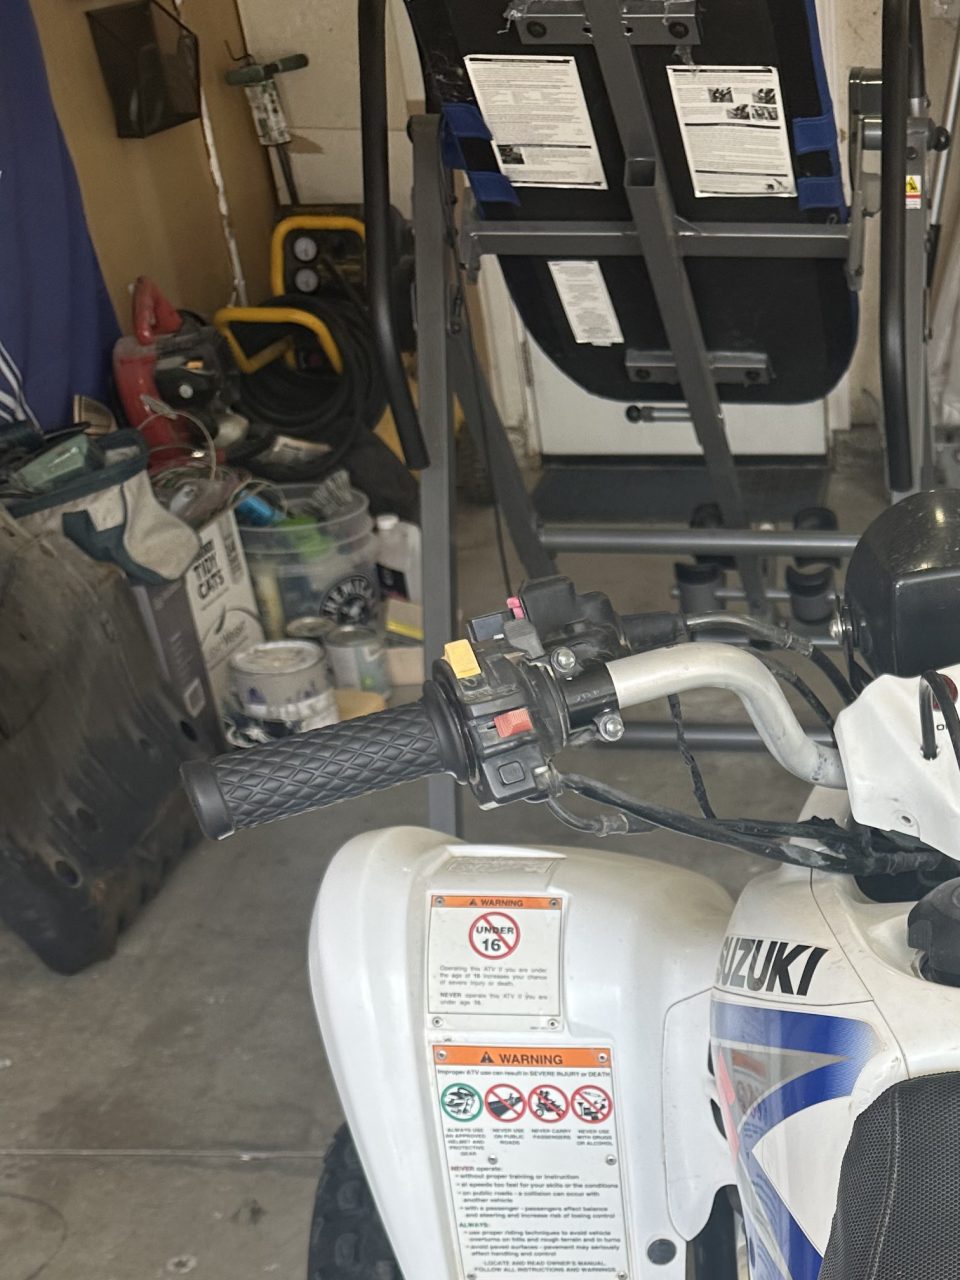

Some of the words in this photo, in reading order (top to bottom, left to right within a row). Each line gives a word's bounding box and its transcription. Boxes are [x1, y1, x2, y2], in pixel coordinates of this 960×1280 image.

[481, 898, 524, 907] WARNING
[476, 926, 514, 935] UNDER
[482, 939, 501, 952] 16
[499, 1053, 563, 1065] WARNING
